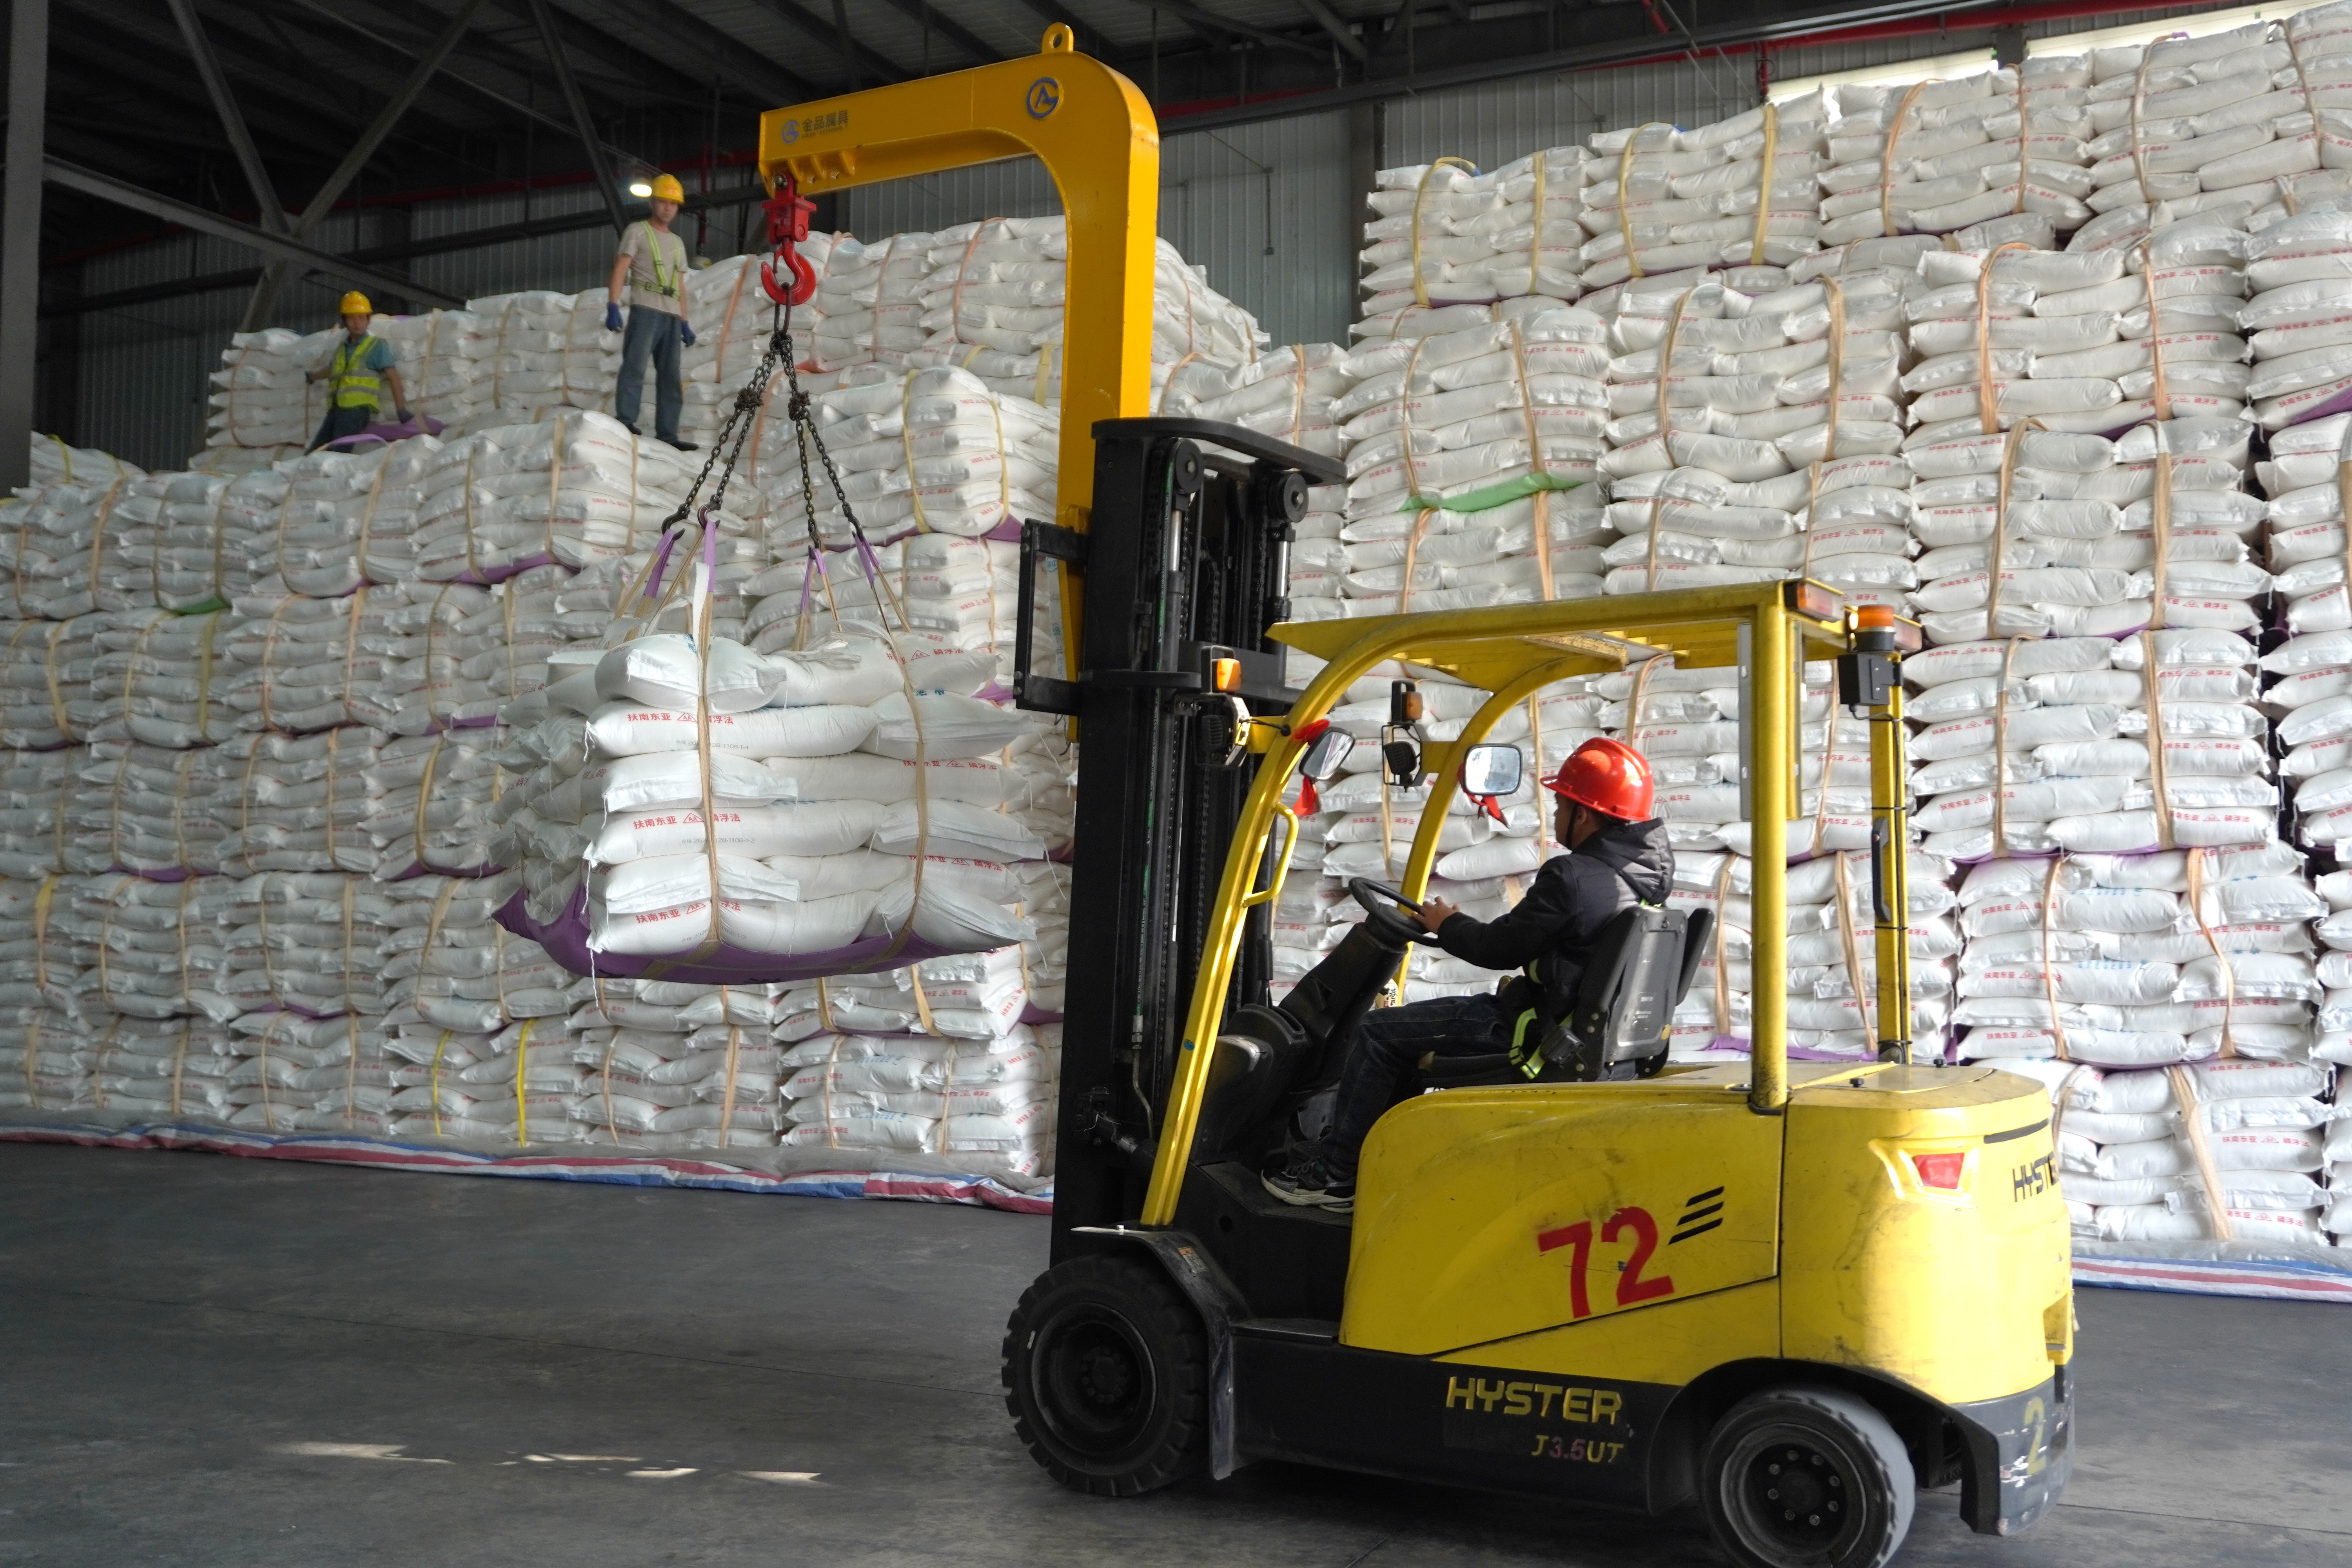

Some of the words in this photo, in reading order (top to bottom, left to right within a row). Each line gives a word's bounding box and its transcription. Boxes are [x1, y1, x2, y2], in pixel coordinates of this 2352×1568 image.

[886, 652, 907, 664] 扶亚
[627, 713, 671, 722] 扶南东亚
[968, 762, 997, 770] 磷浮法
[633, 816, 678, 829] 扶南东亚
[974, 860, 1003, 871] 磷浮法
[635, 909, 681, 924] 扶南东亚
[720, 900, 741, 911] 浮法
[1537, 1206, 1675, 1318] 72
[1446, 1376, 1622, 1425] HYSTER
[2024, 1397, 2047, 1475] 2
[1531, 1435, 1624, 1463] J3.5UT
